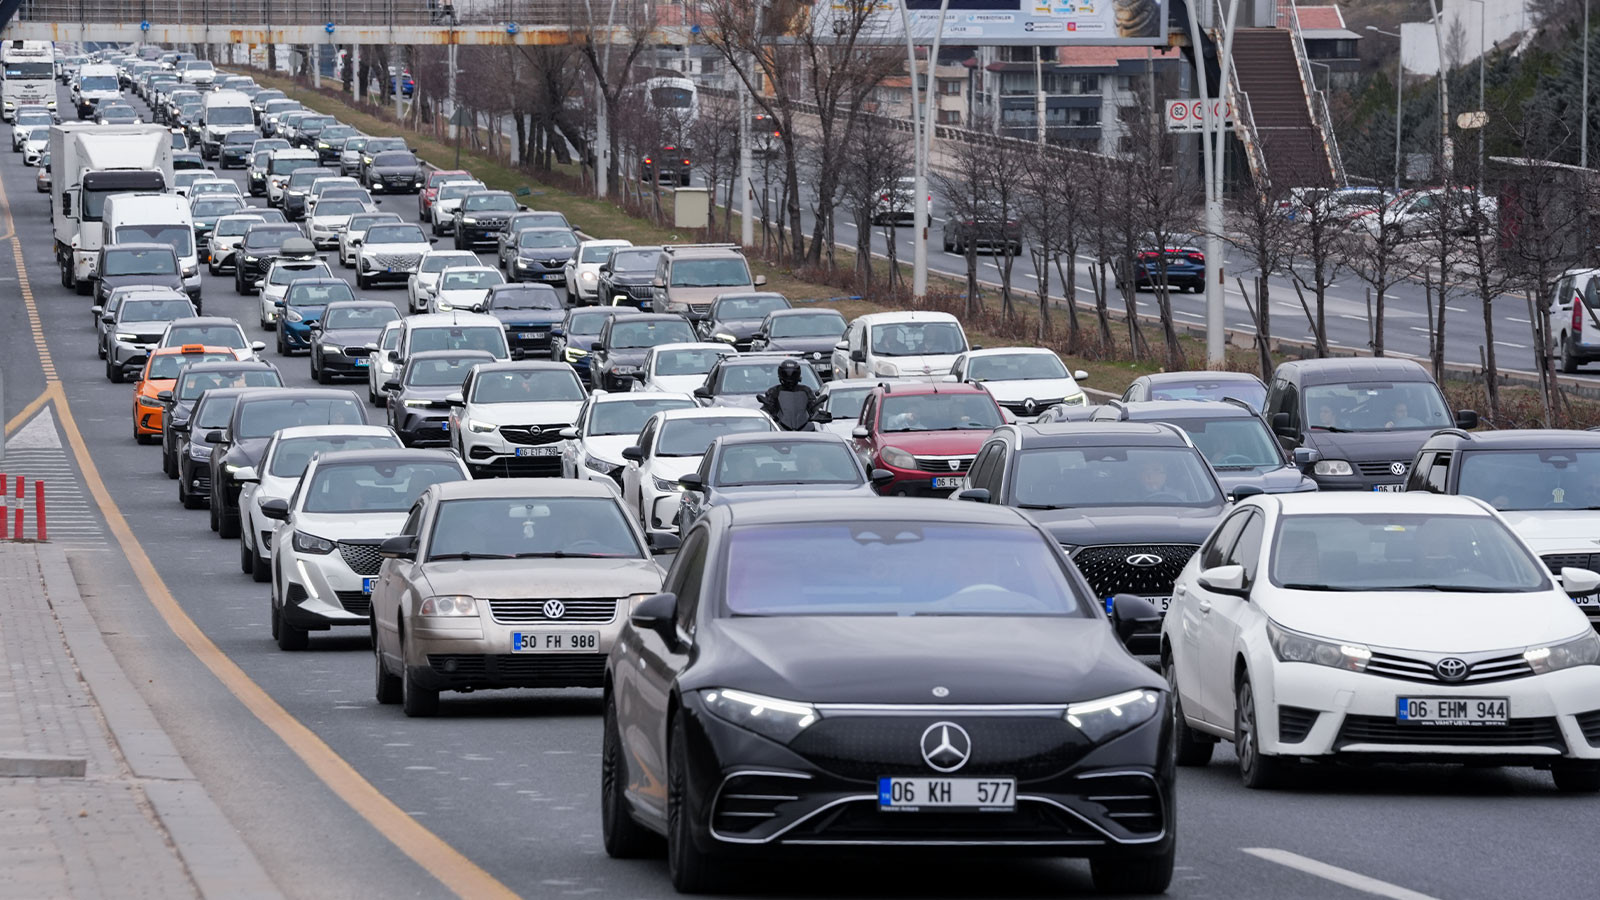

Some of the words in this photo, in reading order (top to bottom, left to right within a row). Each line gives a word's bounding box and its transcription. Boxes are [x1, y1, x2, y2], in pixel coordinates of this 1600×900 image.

[1174, 106, 1184, 116] 82
[937, 478, 946, 486] 06
[949, 478, 959, 486] FL
[521, 635, 537, 648] 50
[546, 635, 562, 648] FH
[571, 635, 595, 648] 988
[1409, 701, 1427, 718] 06
[1438, 701, 1467, 718] EHM
[1477, 702, 1506, 719] 944
[892, 781, 915, 803] 06
[928, 781, 952, 803] KH
[977, 782, 1012, 803] 577
